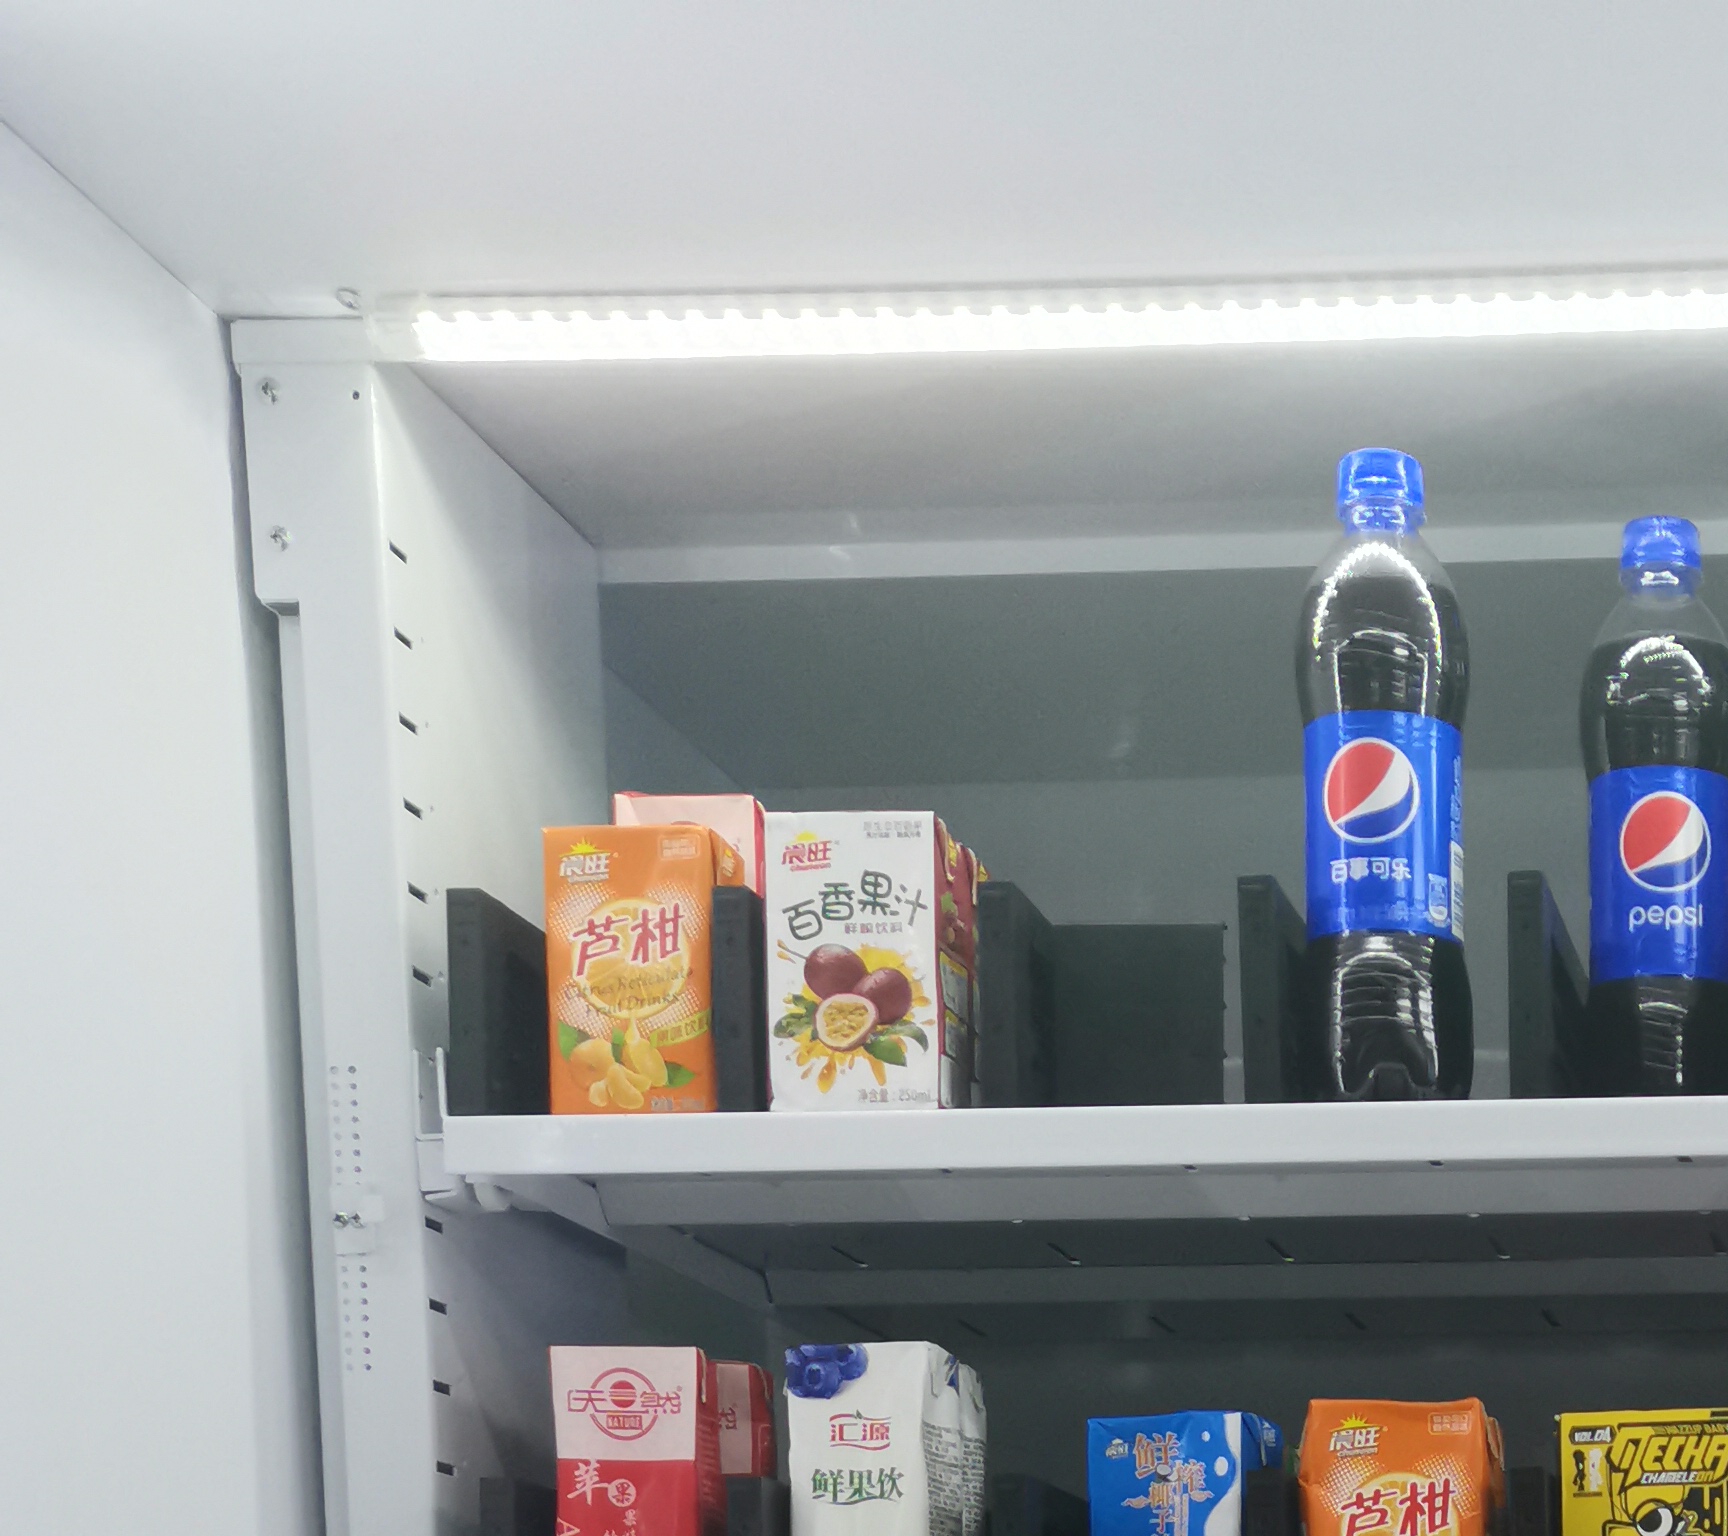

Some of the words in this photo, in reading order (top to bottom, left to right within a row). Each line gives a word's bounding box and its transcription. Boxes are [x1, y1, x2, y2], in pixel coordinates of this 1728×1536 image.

[1329, 857, 1412, 885] 百事可乐
[782, 869, 928, 941] 百香果汁
[1628, 904, 1704, 933] pepsi
[572, 902, 685, 978] 芦柑
[830, 1421, 891, 1444] 汇源
[811, 1467, 905, 1502] 鲜果饮
